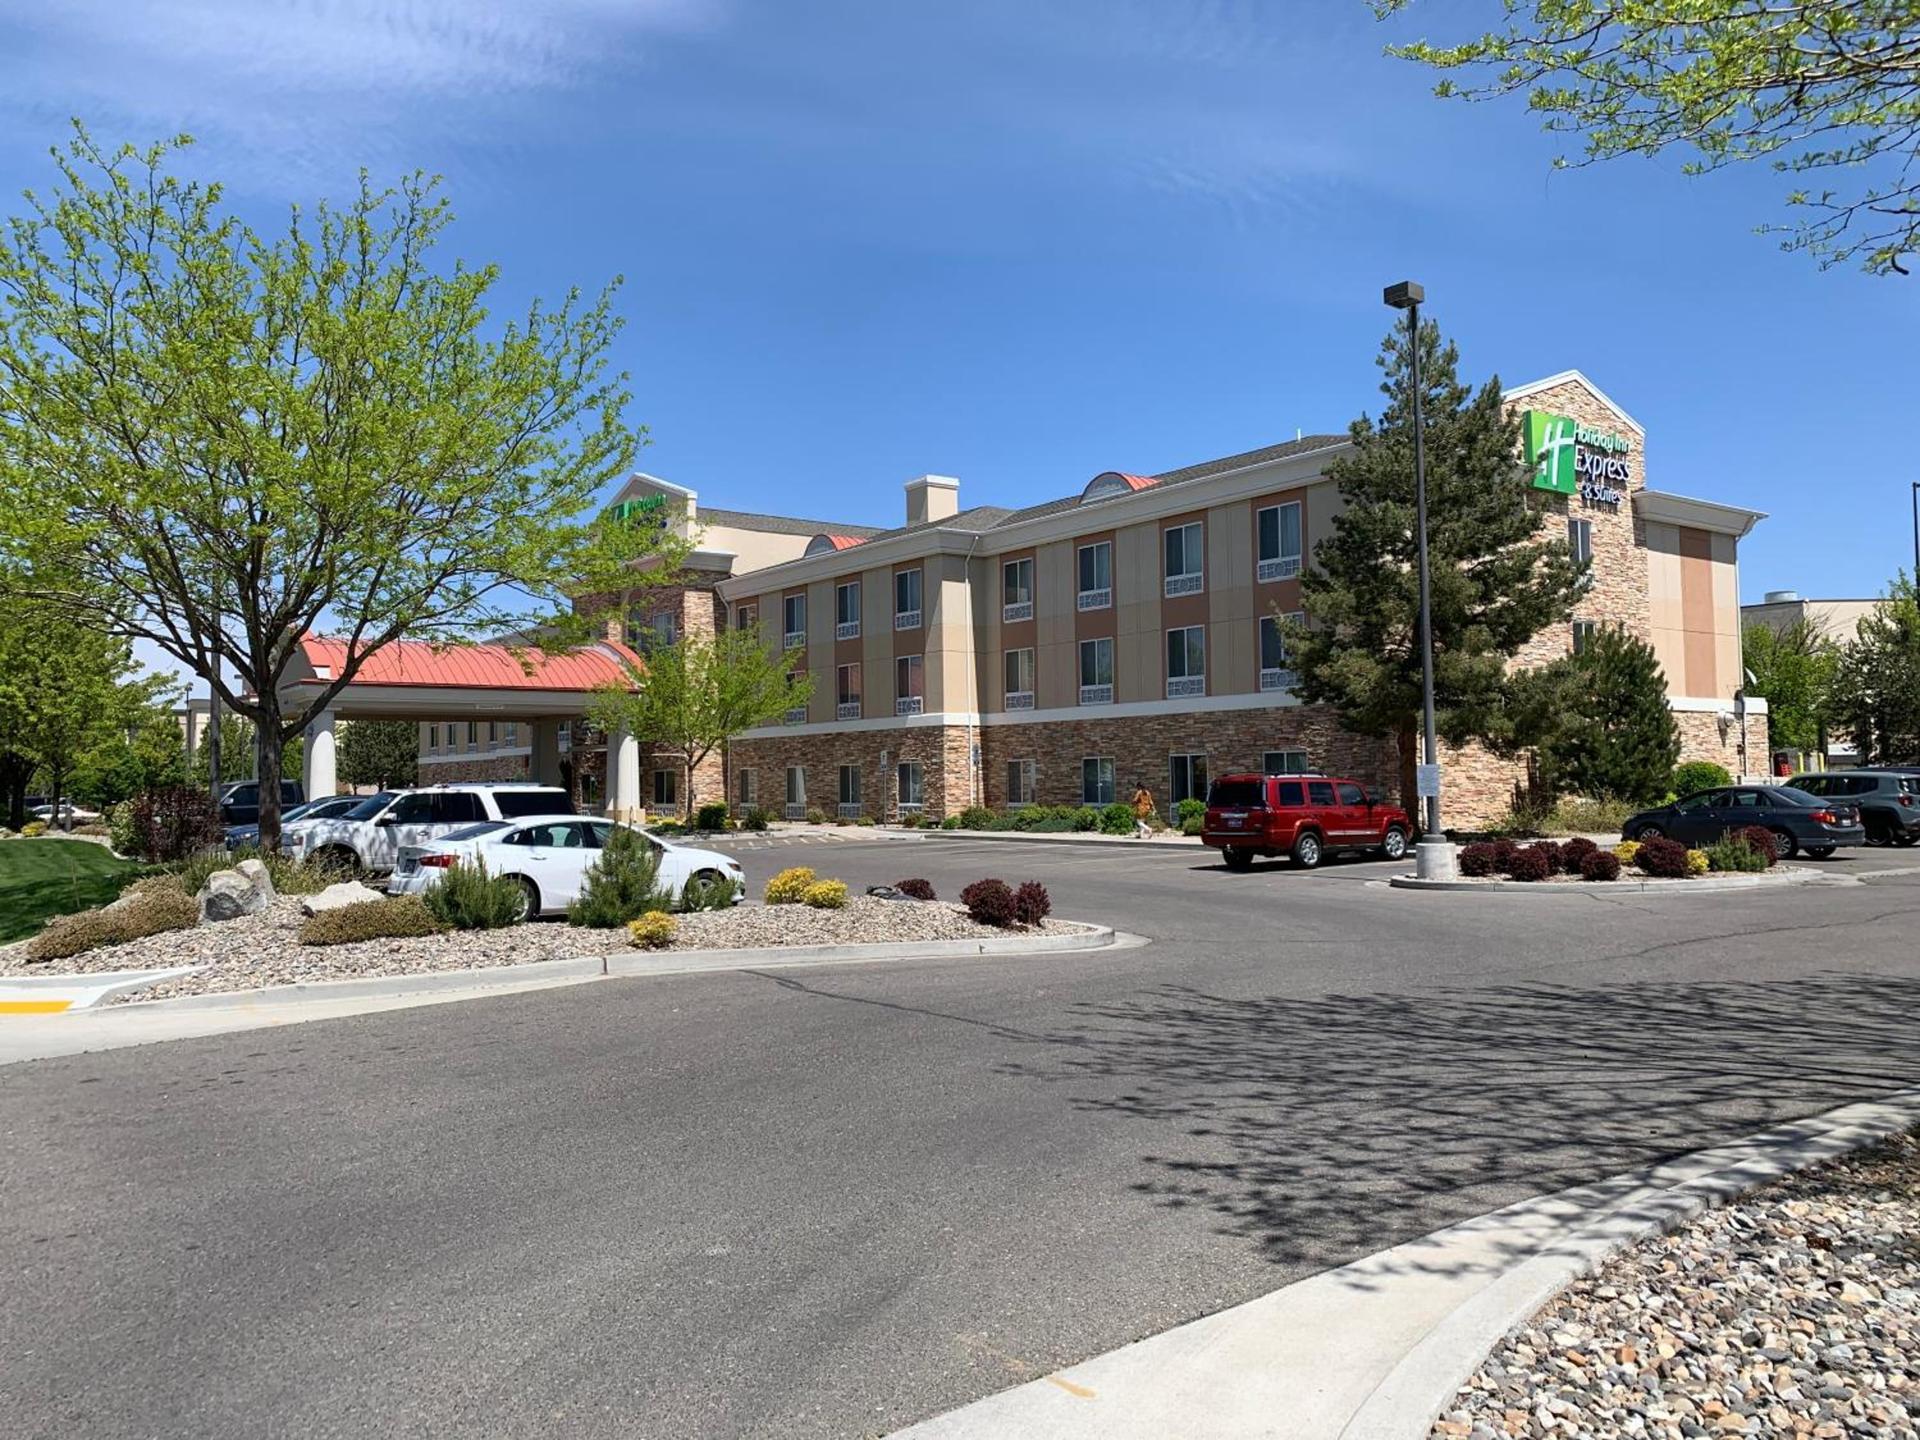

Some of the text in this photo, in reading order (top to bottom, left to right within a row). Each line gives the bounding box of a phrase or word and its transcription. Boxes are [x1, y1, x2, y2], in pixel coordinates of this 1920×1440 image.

[1573, 421, 1633, 453] Holiday Inn
[1575, 445, 1631, 480] Express
[1584, 483, 1622, 504] & Suites
